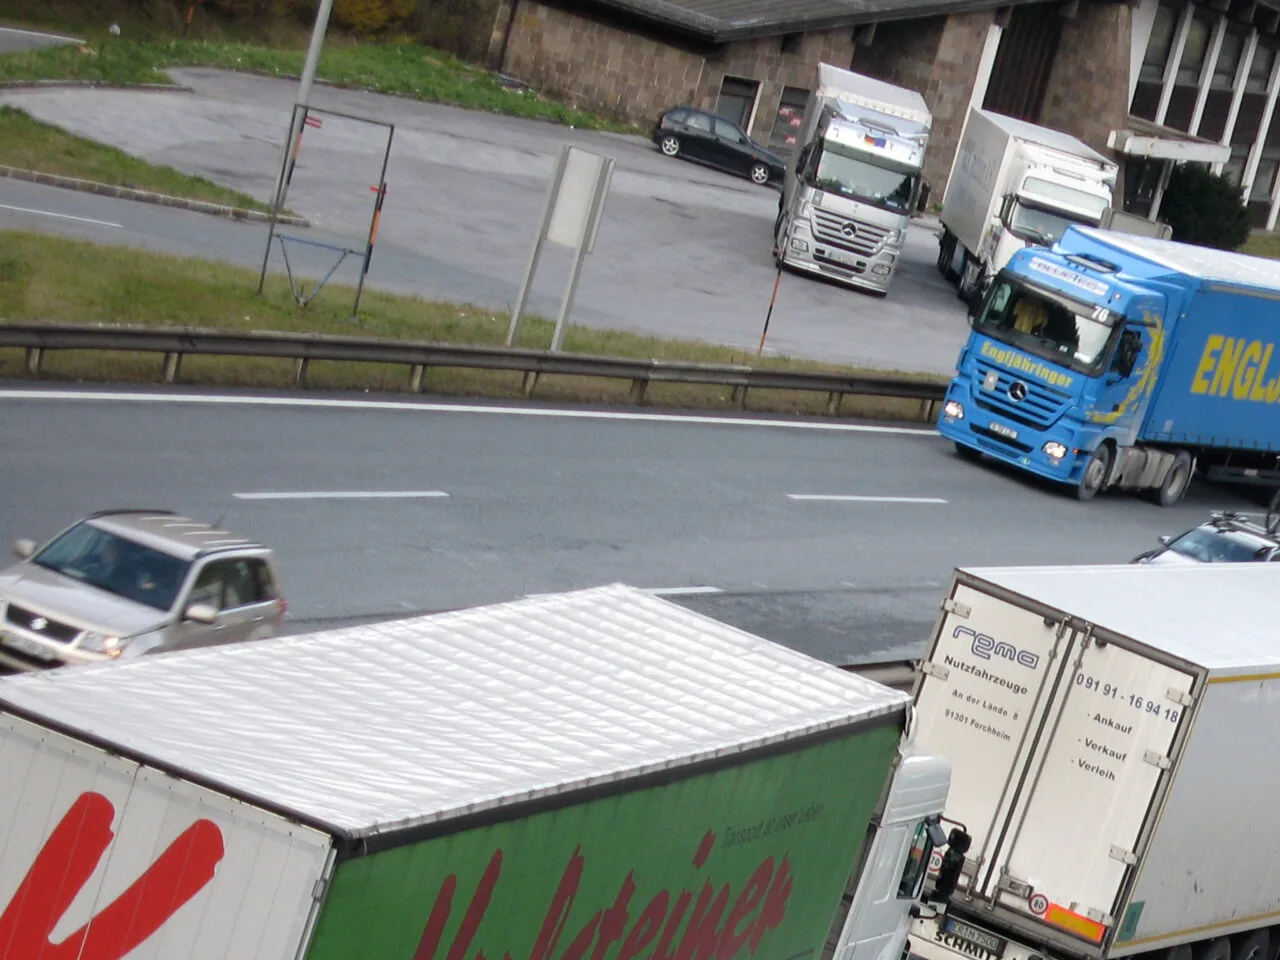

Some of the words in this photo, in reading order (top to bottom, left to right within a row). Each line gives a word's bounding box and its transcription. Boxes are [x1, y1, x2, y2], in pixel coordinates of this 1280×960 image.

[943, 654, 1028, 696] Nutzfahrzeuge
[951, 688, 966, 701] An
[965, 692, 981, 706] der
[969, 716, 1012, 743] Forchheim
[1093, 713, 1134, 735] Ankauf
[1085, 737, 1128, 762] Verkauf
[1078, 758, 1117, 782] Verleih
[1033, 898, 1045, 911] 80
